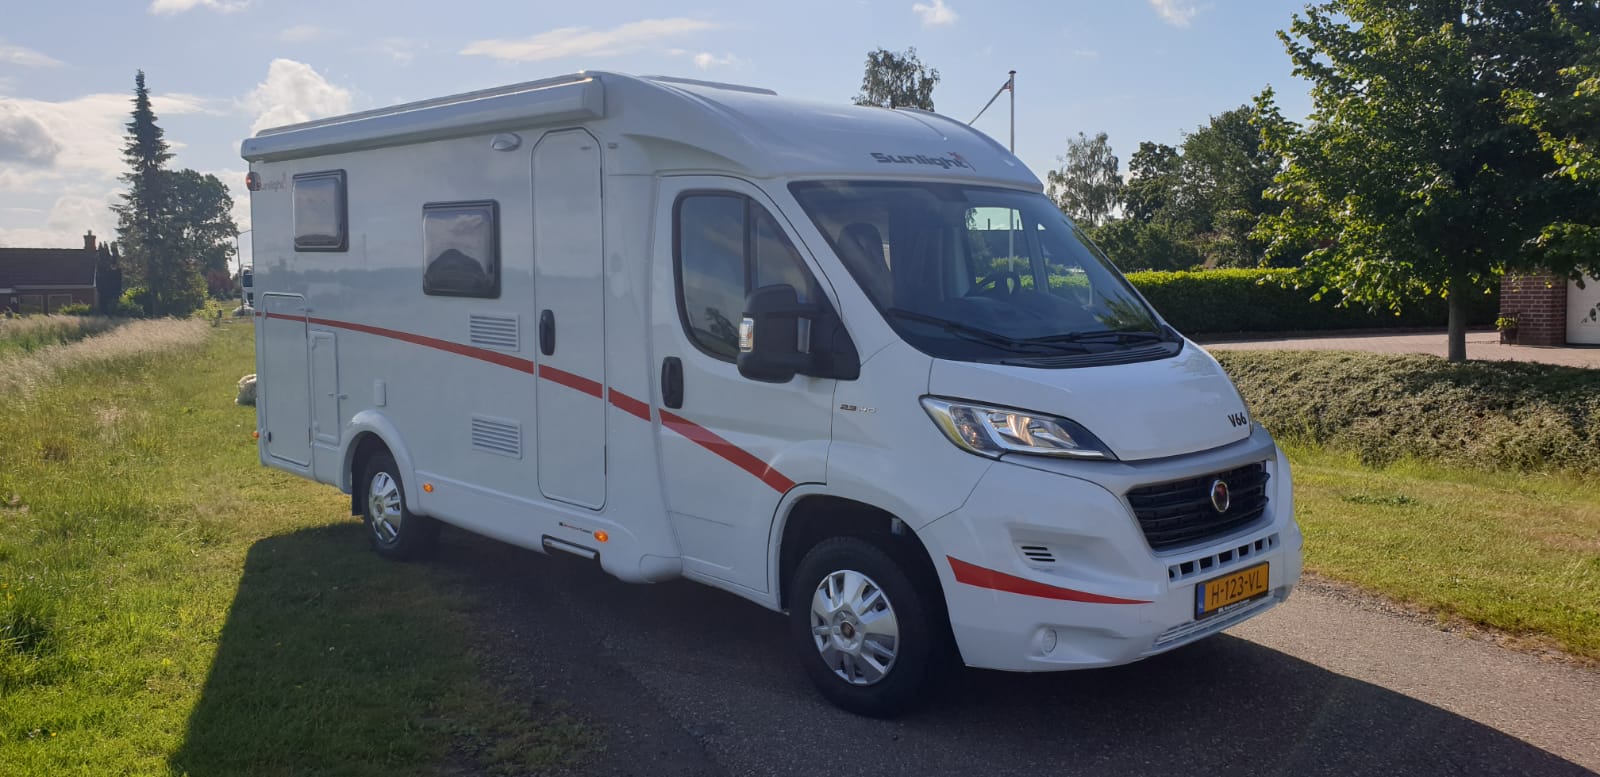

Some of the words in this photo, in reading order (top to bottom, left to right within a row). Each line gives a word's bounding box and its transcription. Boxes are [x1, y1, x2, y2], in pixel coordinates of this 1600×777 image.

[870, 152, 967, 169] Sunlight
[1227, 411, 1247, 427] V66
[1211, 570, 1262, 605] H-123-VL
